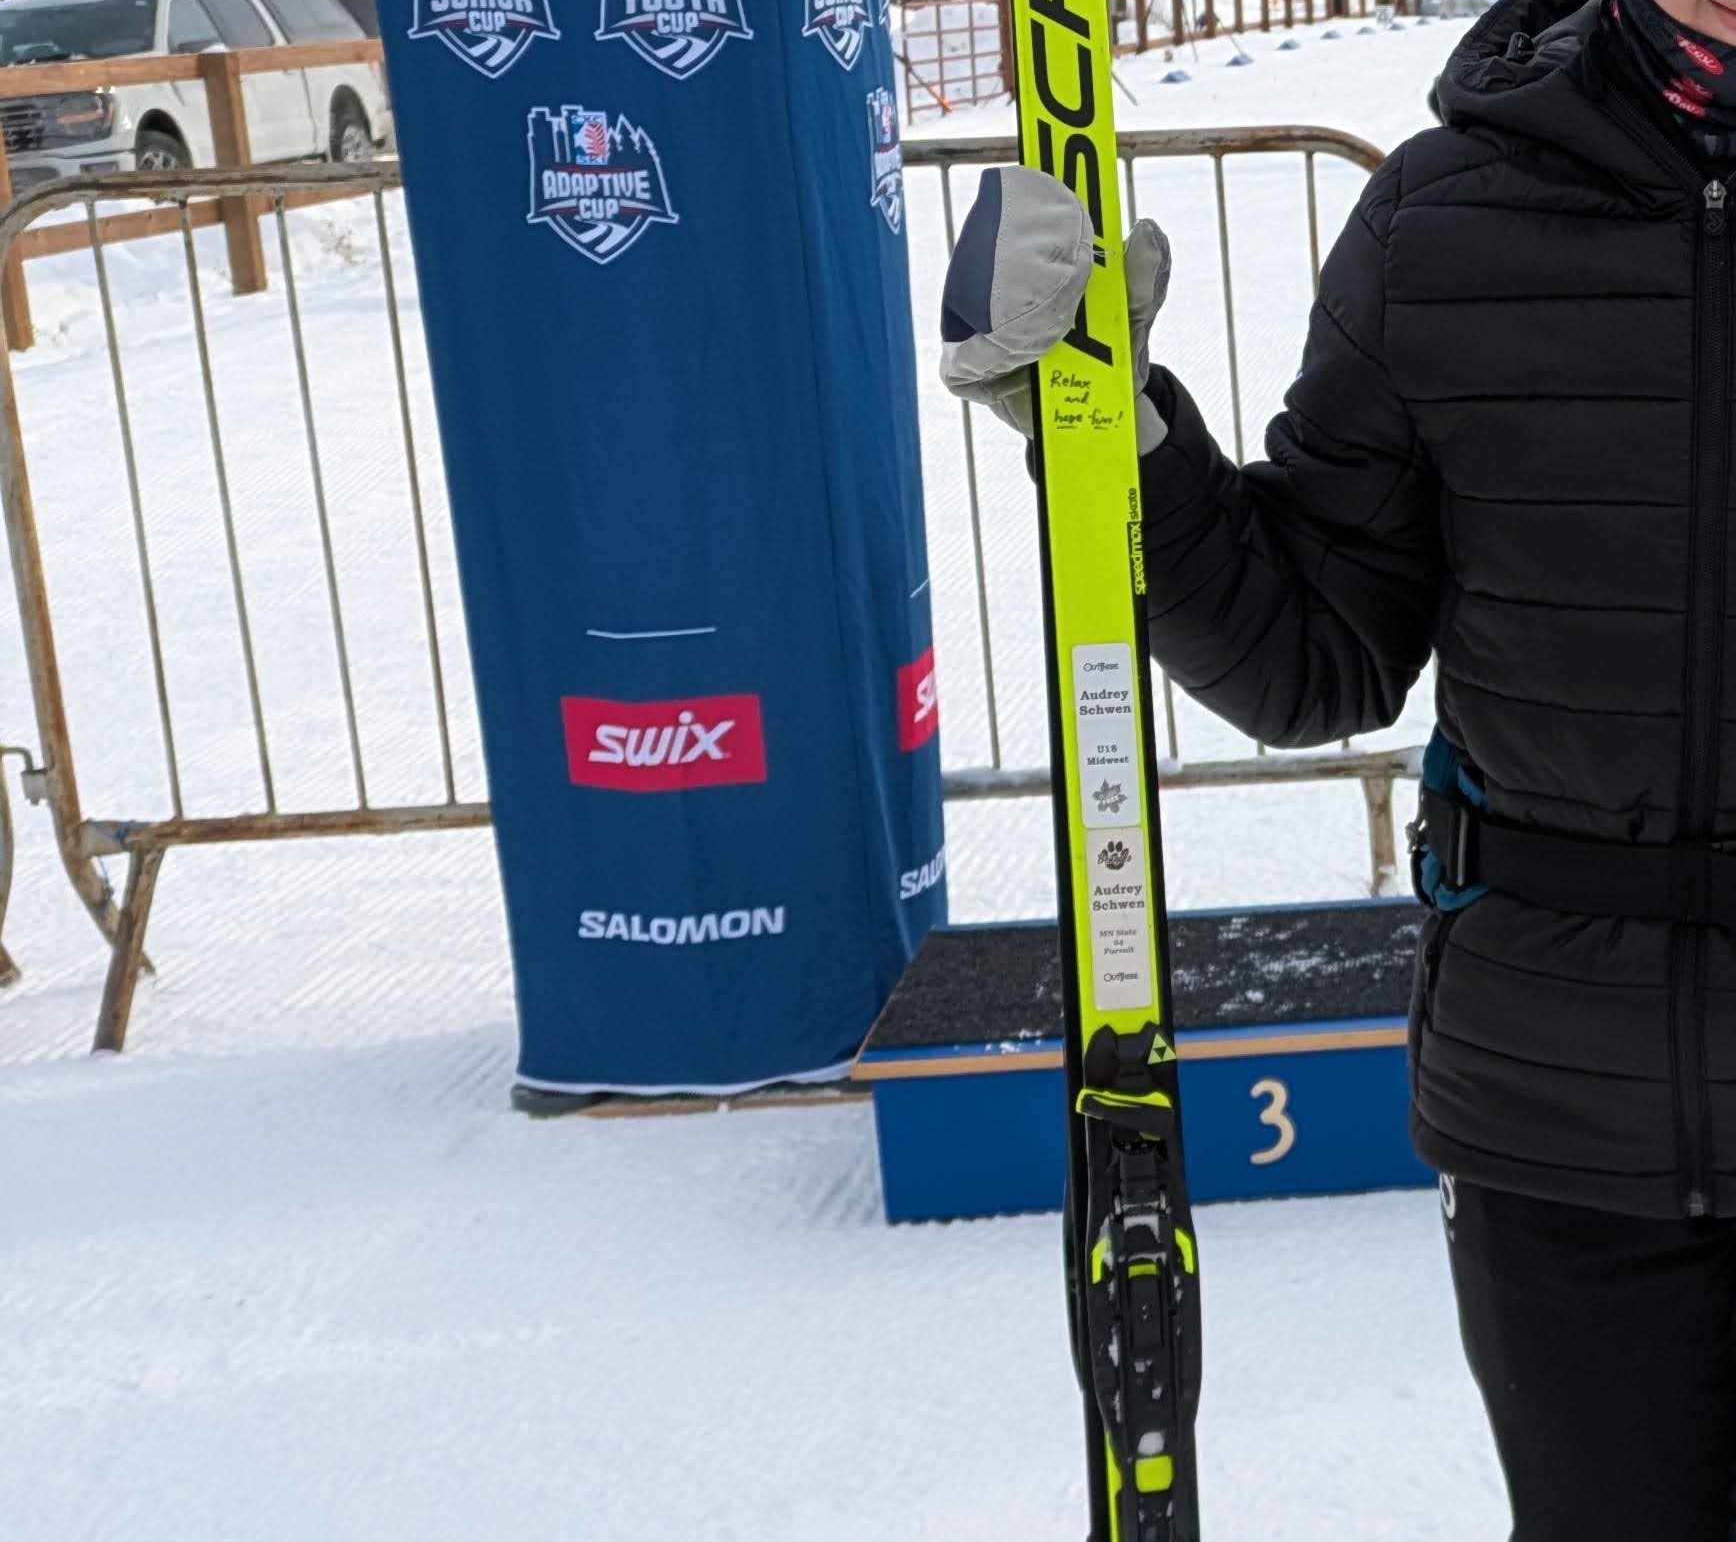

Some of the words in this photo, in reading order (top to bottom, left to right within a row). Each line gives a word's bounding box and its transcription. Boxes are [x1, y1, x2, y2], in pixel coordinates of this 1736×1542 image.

[468, 11, 506, 32] CUP
[656, 11, 698, 33] CUP
[542, 170, 650, 199] ADAPTIVE
[578, 198, 620, 219] CUP
[1050, 370, 1091, 389] Relax
[1064, 391, 1089, 404] and
[1054, 409, 1083, 426] have
[1127, 488, 1139, 520] skate
[1080, 689, 1129, 702] Audrey
[1079, 705, 1132, 716] Schwen
[1087, 756, 1129, 766] Midwest
[1094, 884, 1142, 896] Audrey
[1093, 900, 1145, 911] Schwen
[578, 906, 786, 945] SALOMON
[1250, 1079, 1295, 1165] 3
